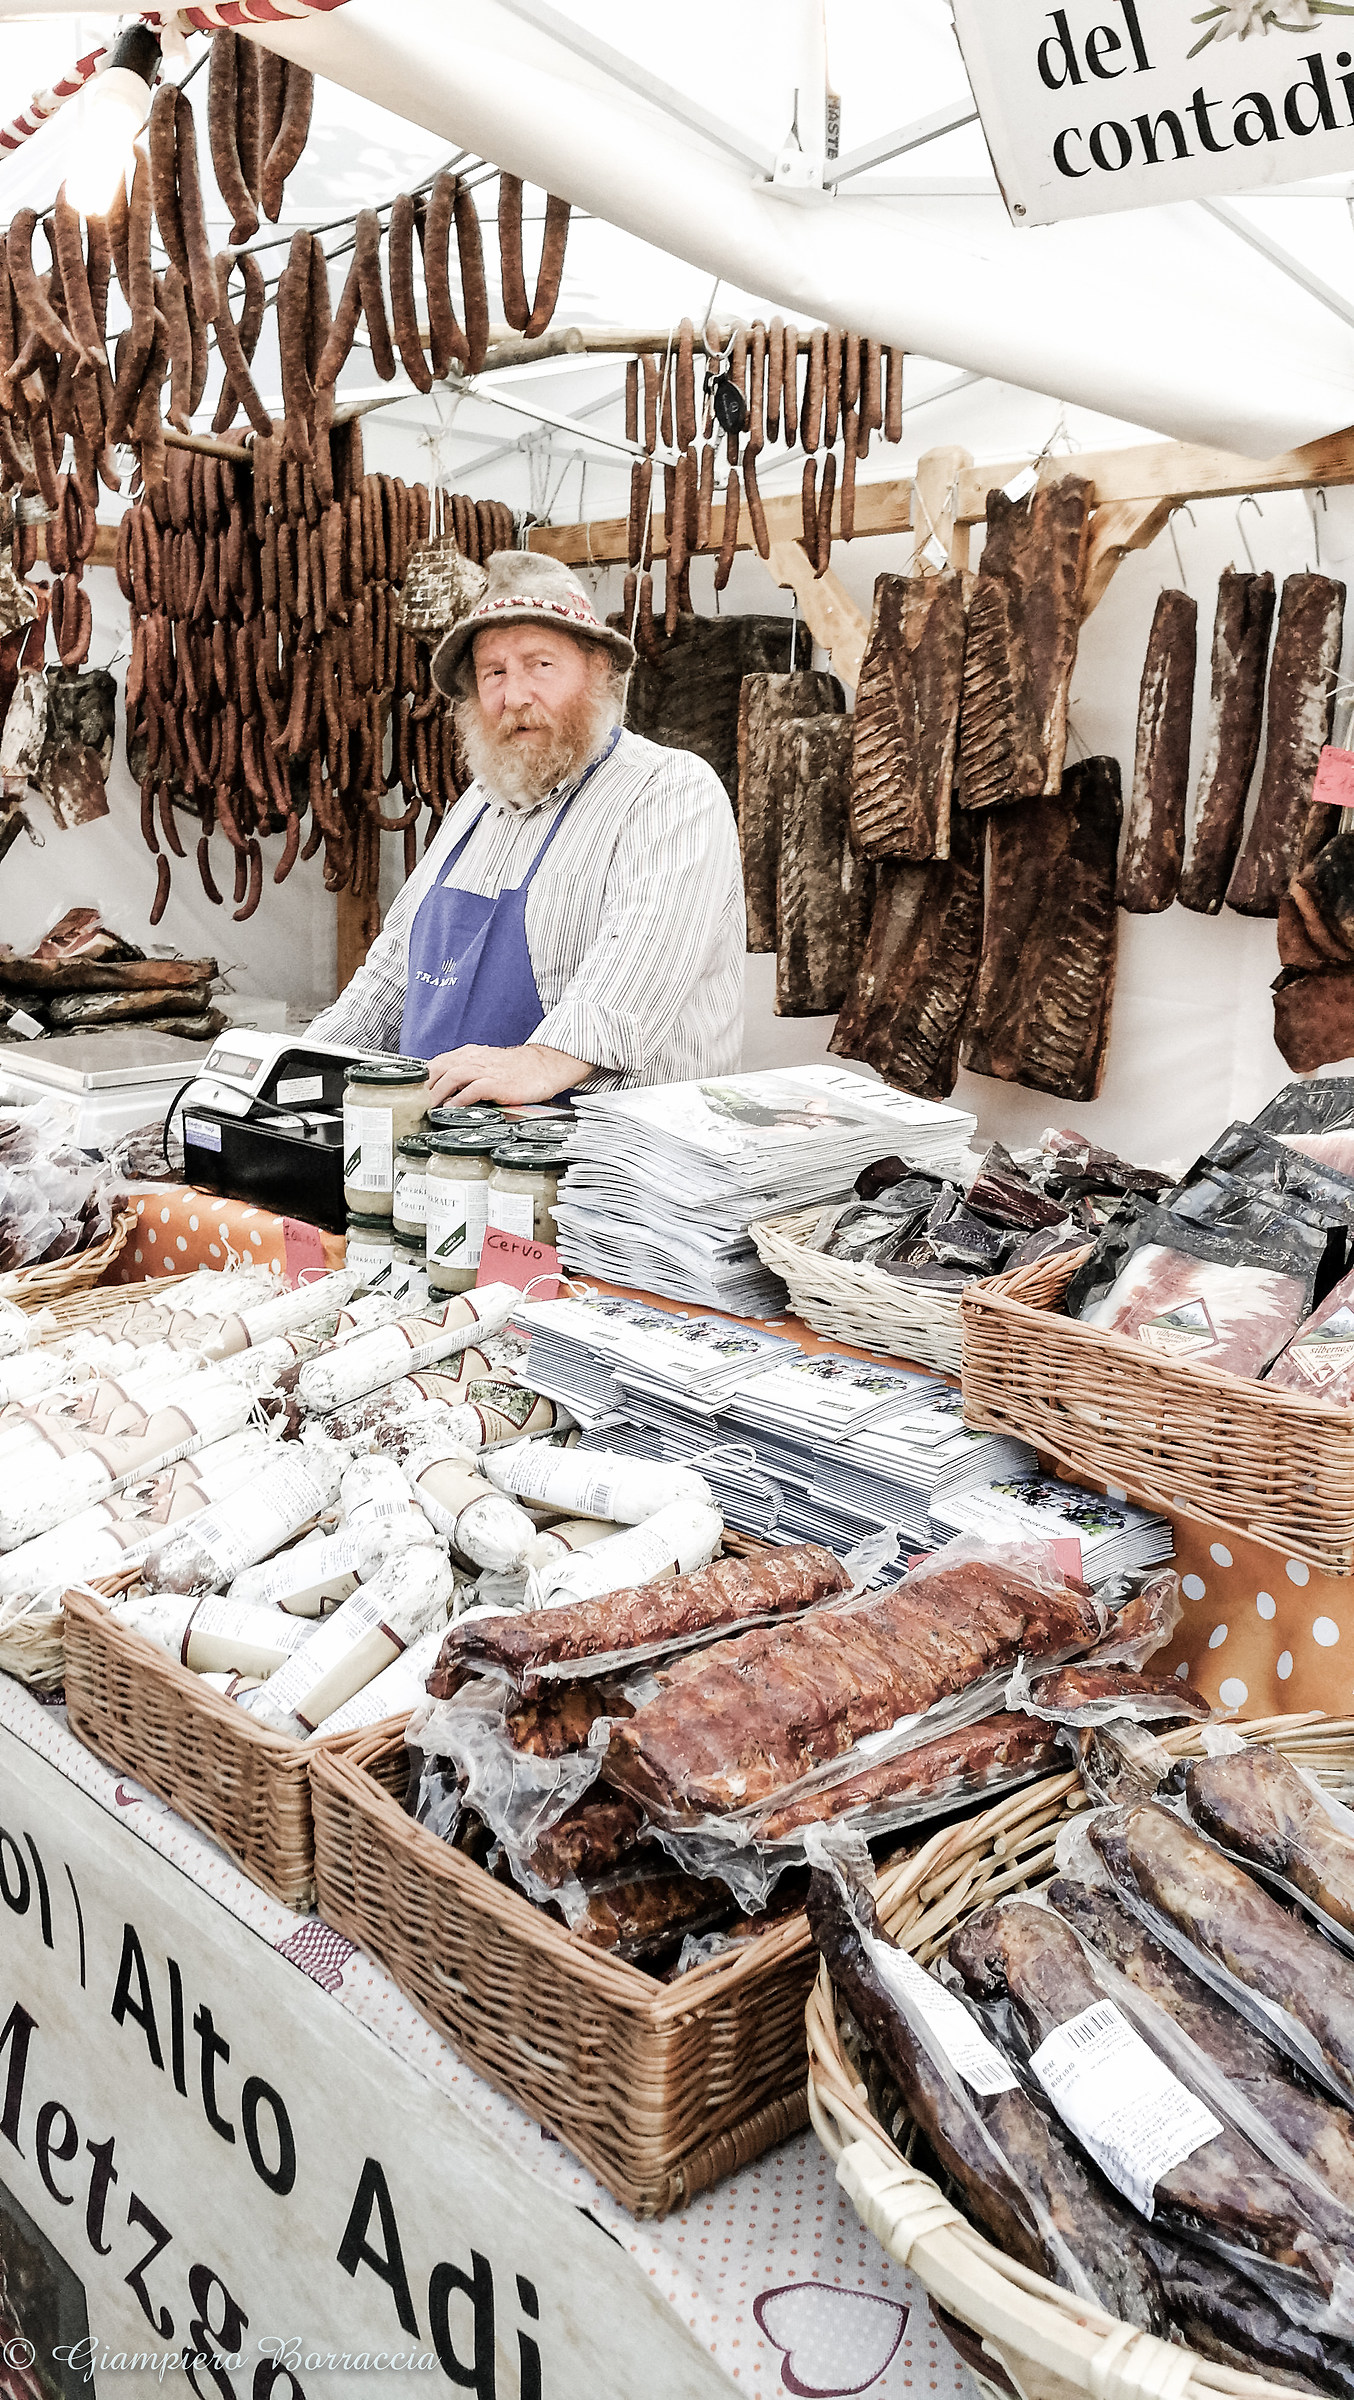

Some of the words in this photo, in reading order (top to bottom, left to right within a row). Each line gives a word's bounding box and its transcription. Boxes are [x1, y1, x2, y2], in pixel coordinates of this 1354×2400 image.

[1037, 0, 1156, 90] del
[1053, 51, 1354, 178] contadi
[487, 1234, 543, 1260] Cervo
[111, 1922, 297, 2196] Alto
